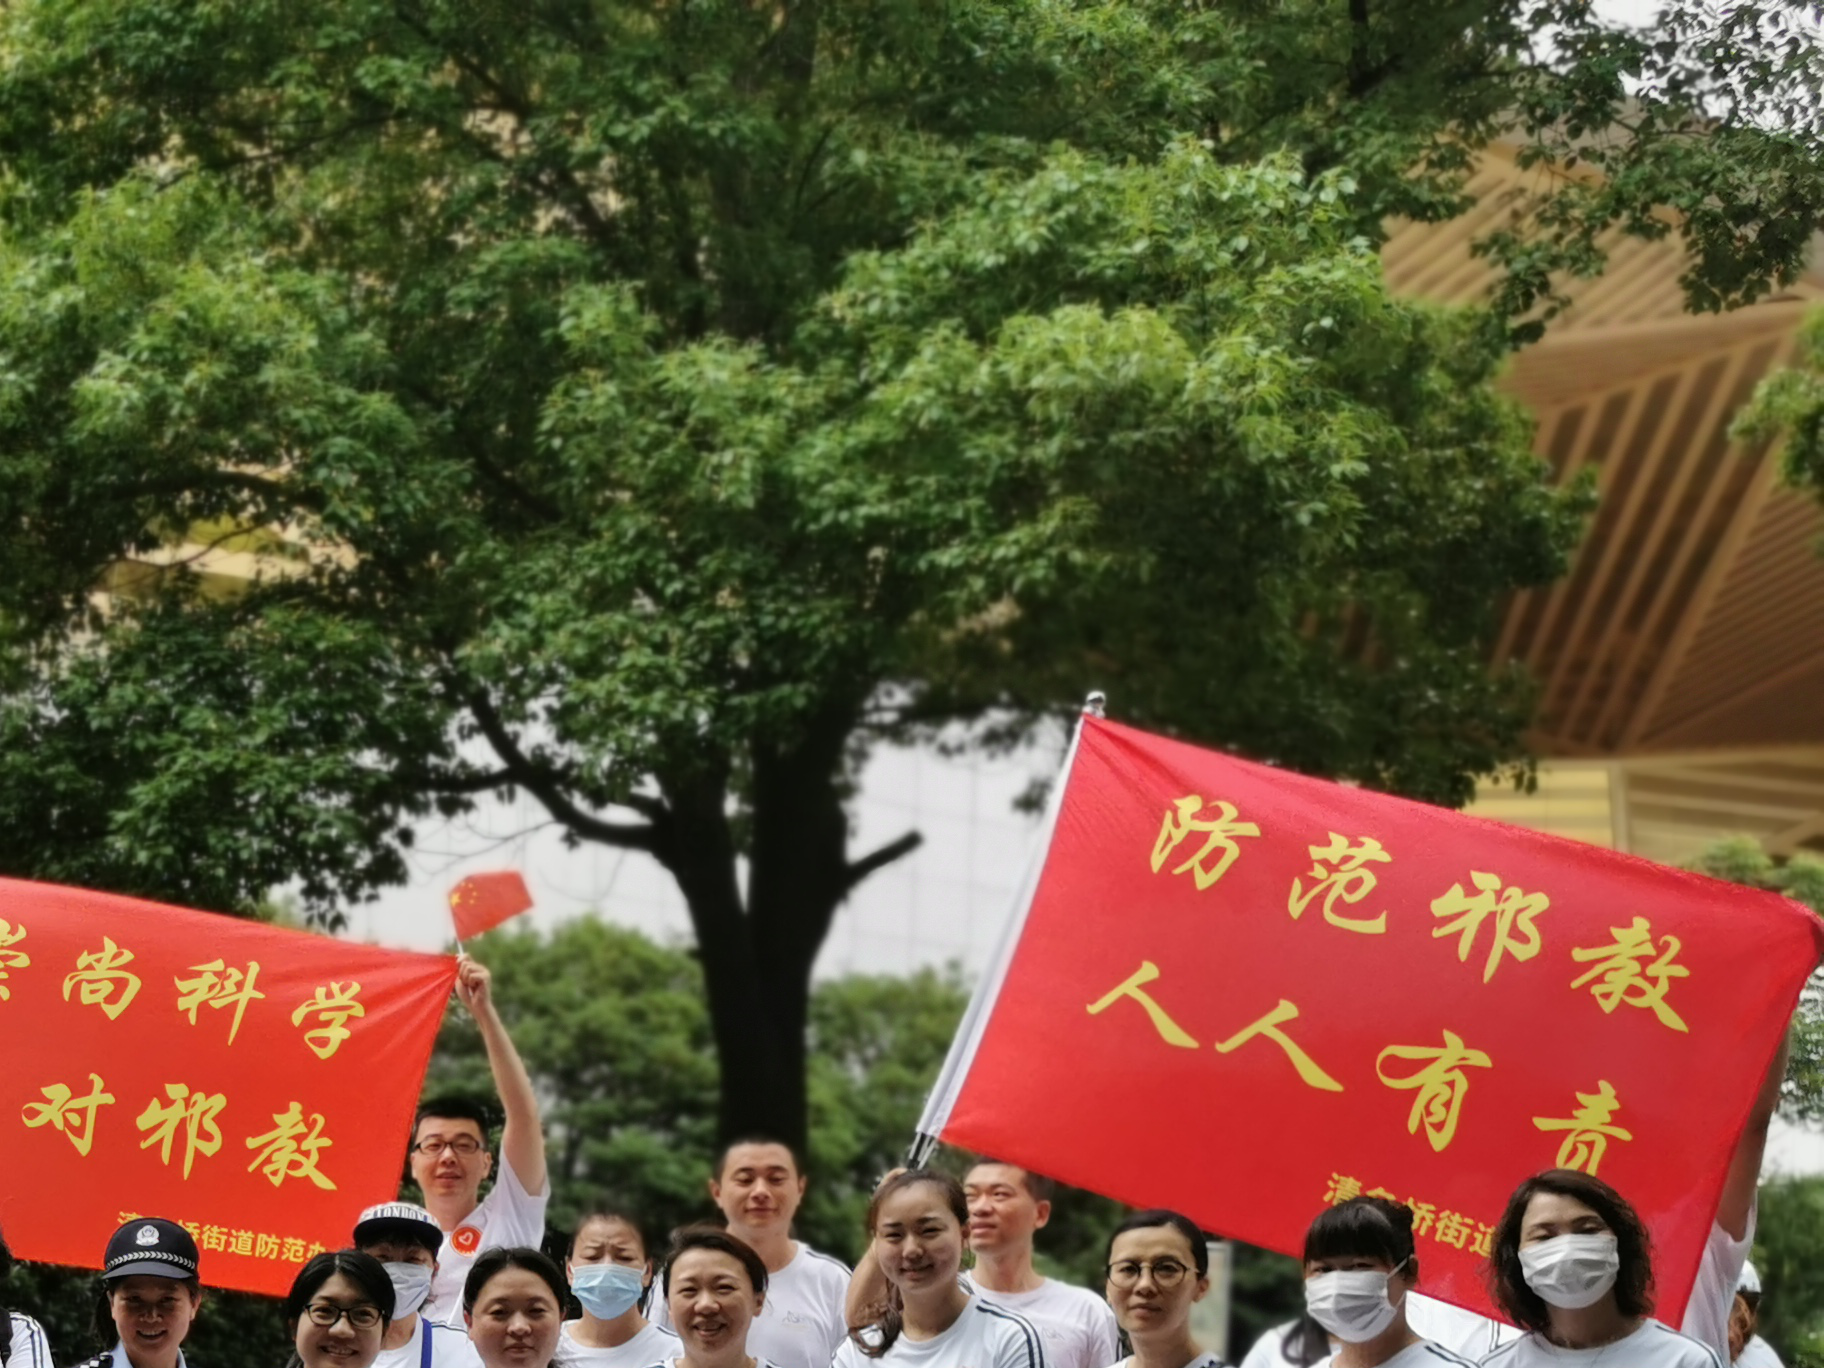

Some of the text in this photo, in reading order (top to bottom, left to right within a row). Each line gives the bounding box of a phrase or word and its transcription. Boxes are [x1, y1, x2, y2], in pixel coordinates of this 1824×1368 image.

[1150, 795, 1690, 1032] 防范邪教
[1086, 960, 1633, 1177] 人人有责
